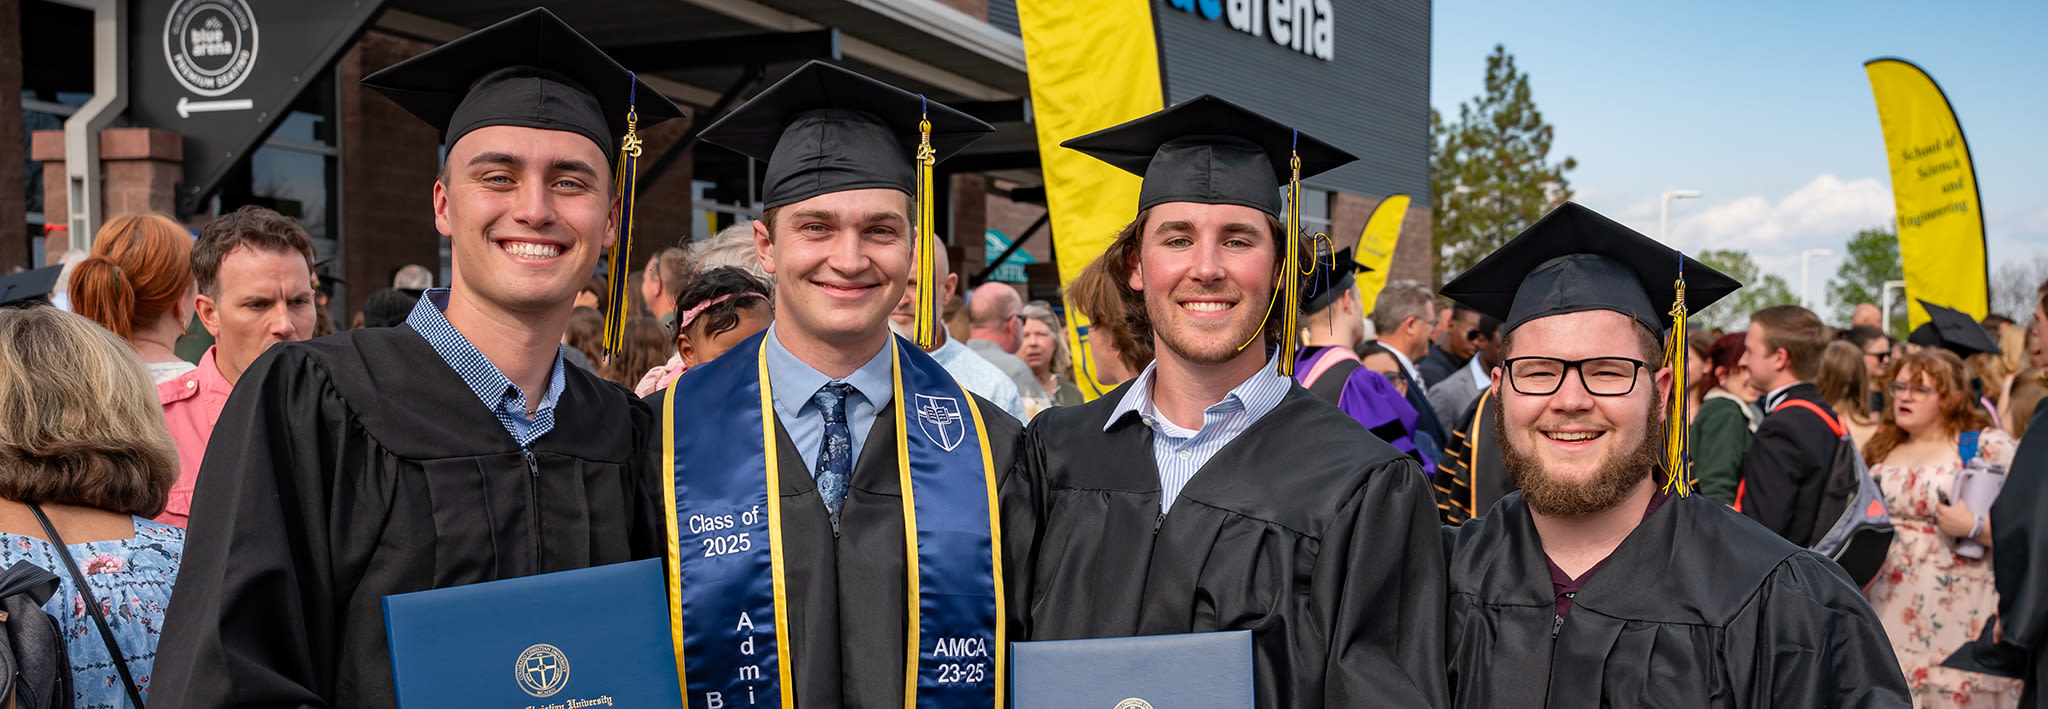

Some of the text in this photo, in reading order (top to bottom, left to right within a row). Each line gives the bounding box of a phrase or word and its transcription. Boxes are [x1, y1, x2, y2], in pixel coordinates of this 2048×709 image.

[191, 28, 224, 44] blue
[192, 41, 233, 57] arena
[174, 49, 250, 88] PREMIUM SEATING
[621, 133, 643, 158] 25
[916, 143, 936, 166] 25
[1902, 131, 1957, 161] School of
[1917, 157, 1961, 179] Science
[1942, 176, 1964, 194] and
[1899, 201, 1968, 229] Engineering
[689, 505, 759, 534] Class of
[703, 532, 751, 558] 2025
[933, 637, 988, 657] AMCA
[938, 663, 985, 683] 23-25
[566, 695, 613, 709] University
